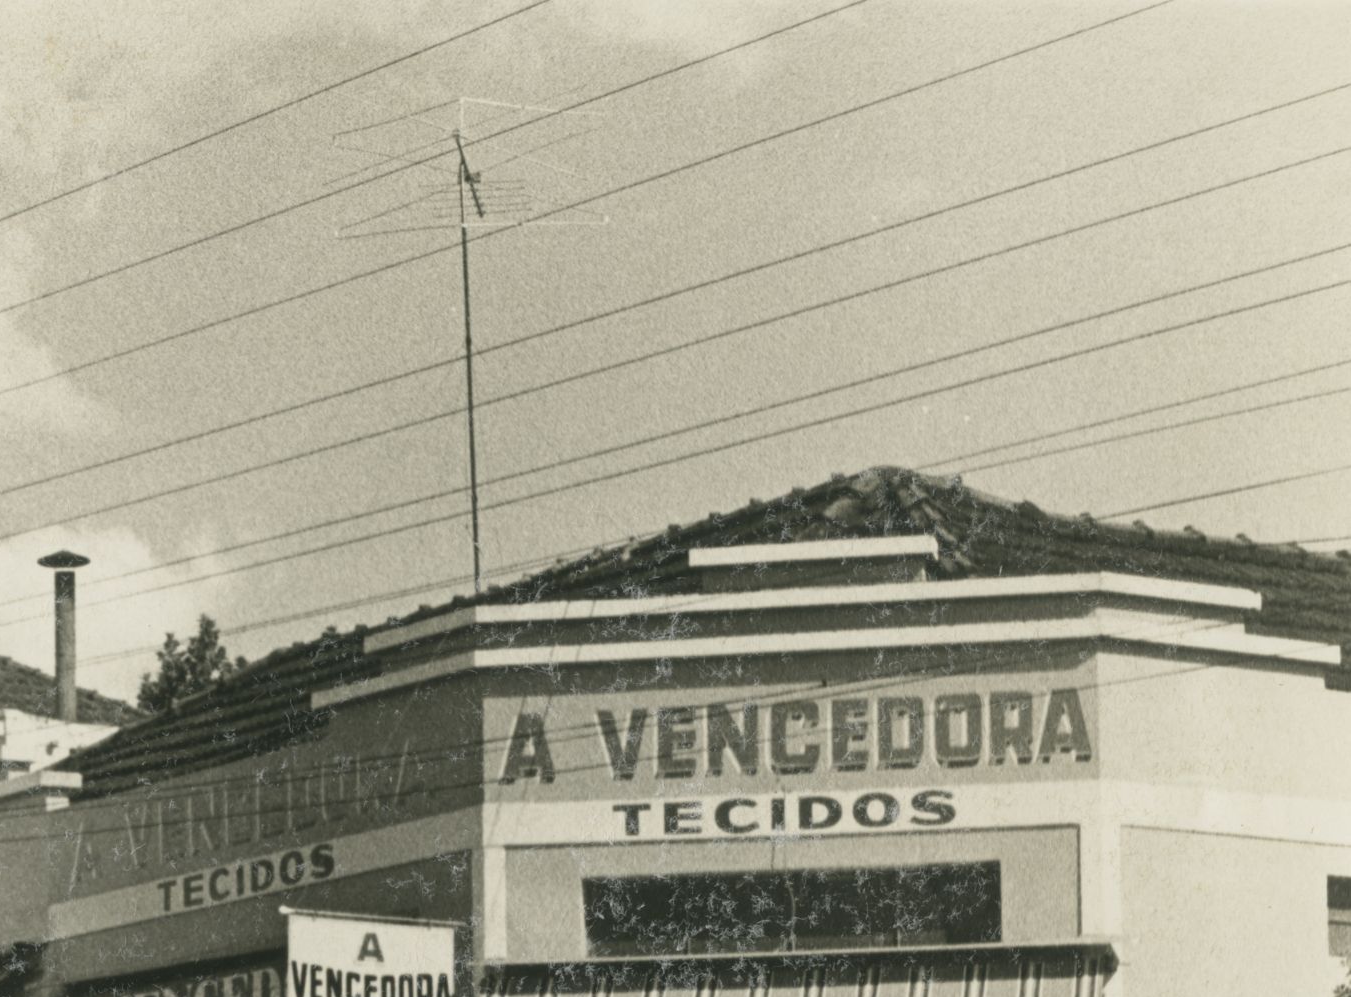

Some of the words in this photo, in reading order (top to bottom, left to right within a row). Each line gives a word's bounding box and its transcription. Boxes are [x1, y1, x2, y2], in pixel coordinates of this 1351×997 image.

[499, 711, 555, 784] A
[597, 688, 1092, 781] VENCEDORA
[613, 789, 957, 837] TECIDOS
[157, 843, 336, 912] TECIDOS
[357, 932, 384, 962] A
